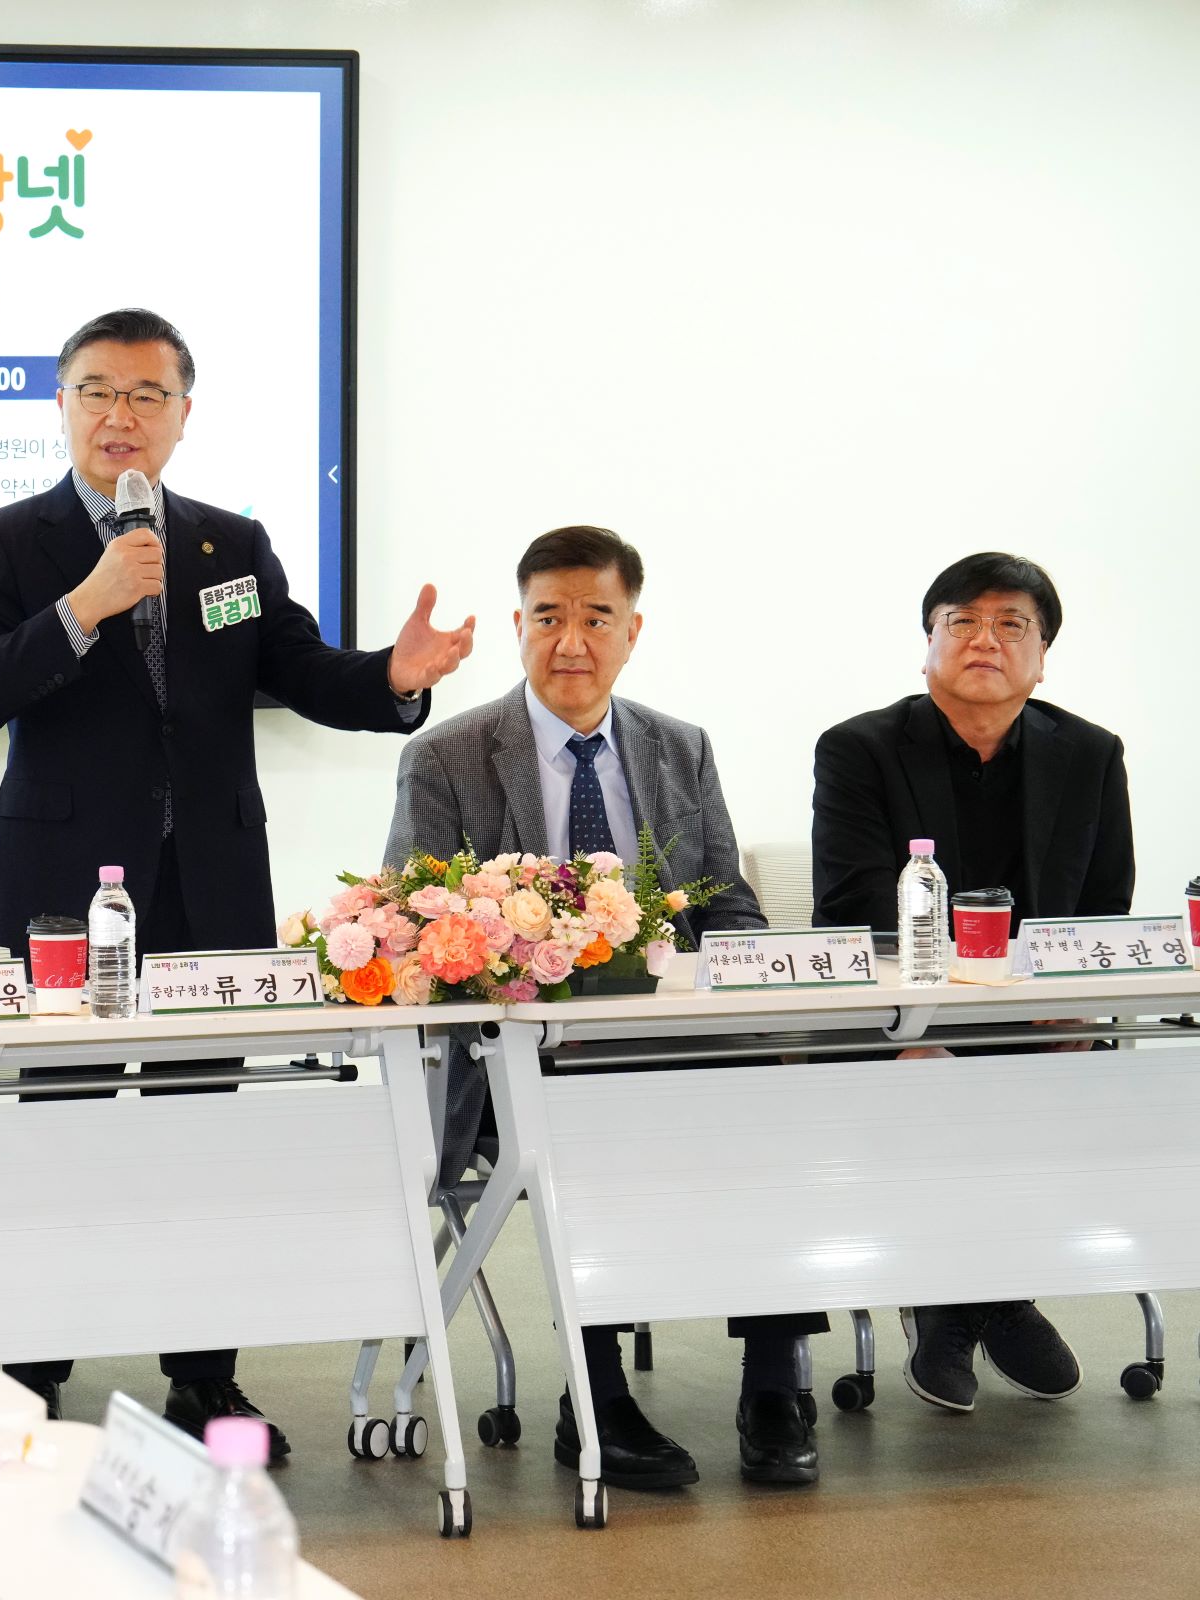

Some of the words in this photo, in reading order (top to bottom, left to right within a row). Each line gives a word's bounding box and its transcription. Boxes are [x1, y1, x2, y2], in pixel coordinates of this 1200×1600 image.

[203, 579, 256, 605] 중랑구청장
[206, 593, 260, 630] 류경기
[1029, 939, 1084, 952] 북부병원
[708, 953, 766, 966] 서울의료원
[151, 985, 210, 998] 중랑구청장
